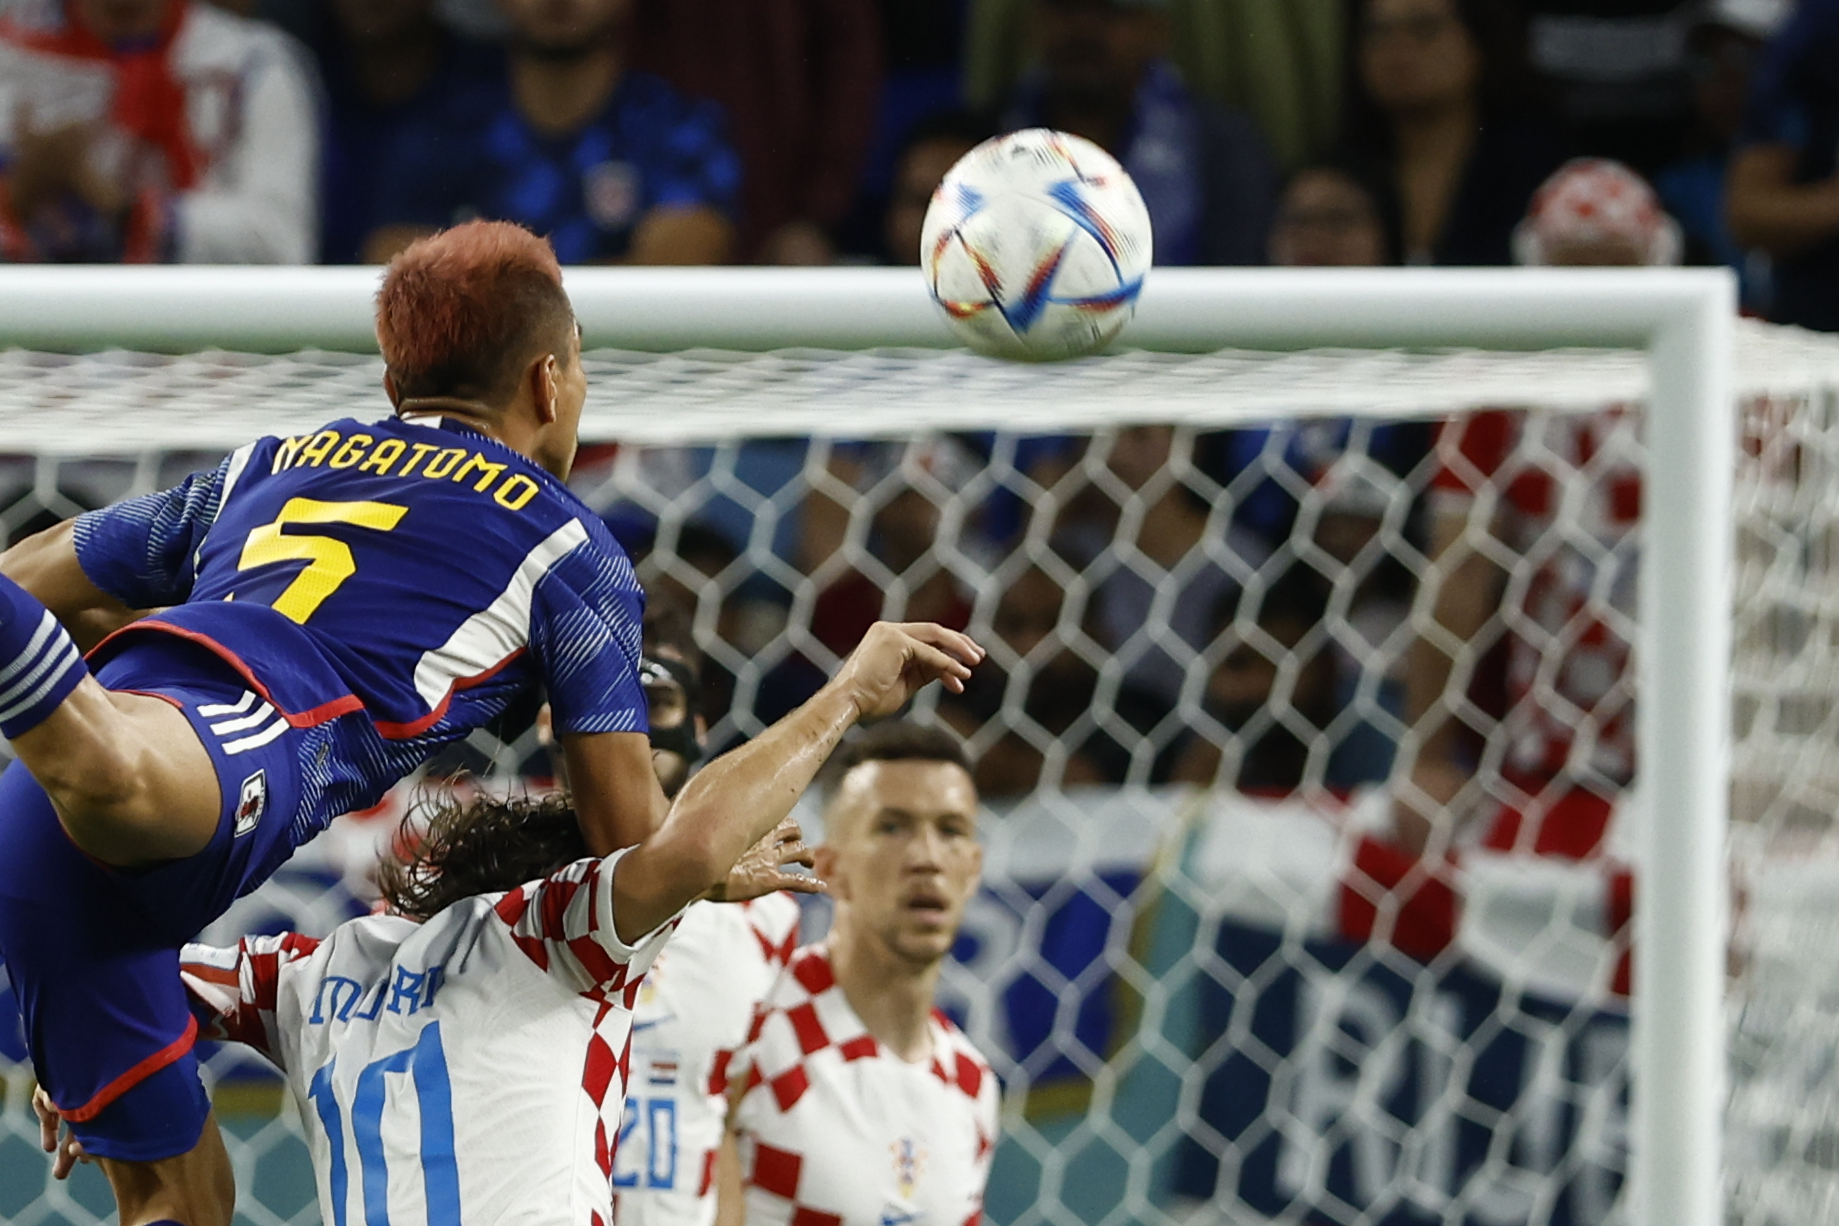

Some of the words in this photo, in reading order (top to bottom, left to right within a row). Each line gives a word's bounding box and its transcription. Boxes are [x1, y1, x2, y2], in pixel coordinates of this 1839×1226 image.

[271, 430, 540, 511] NAGATOMO
[225, 496, 410, 625] 5
[612, 1097, 677, 1190] 20
